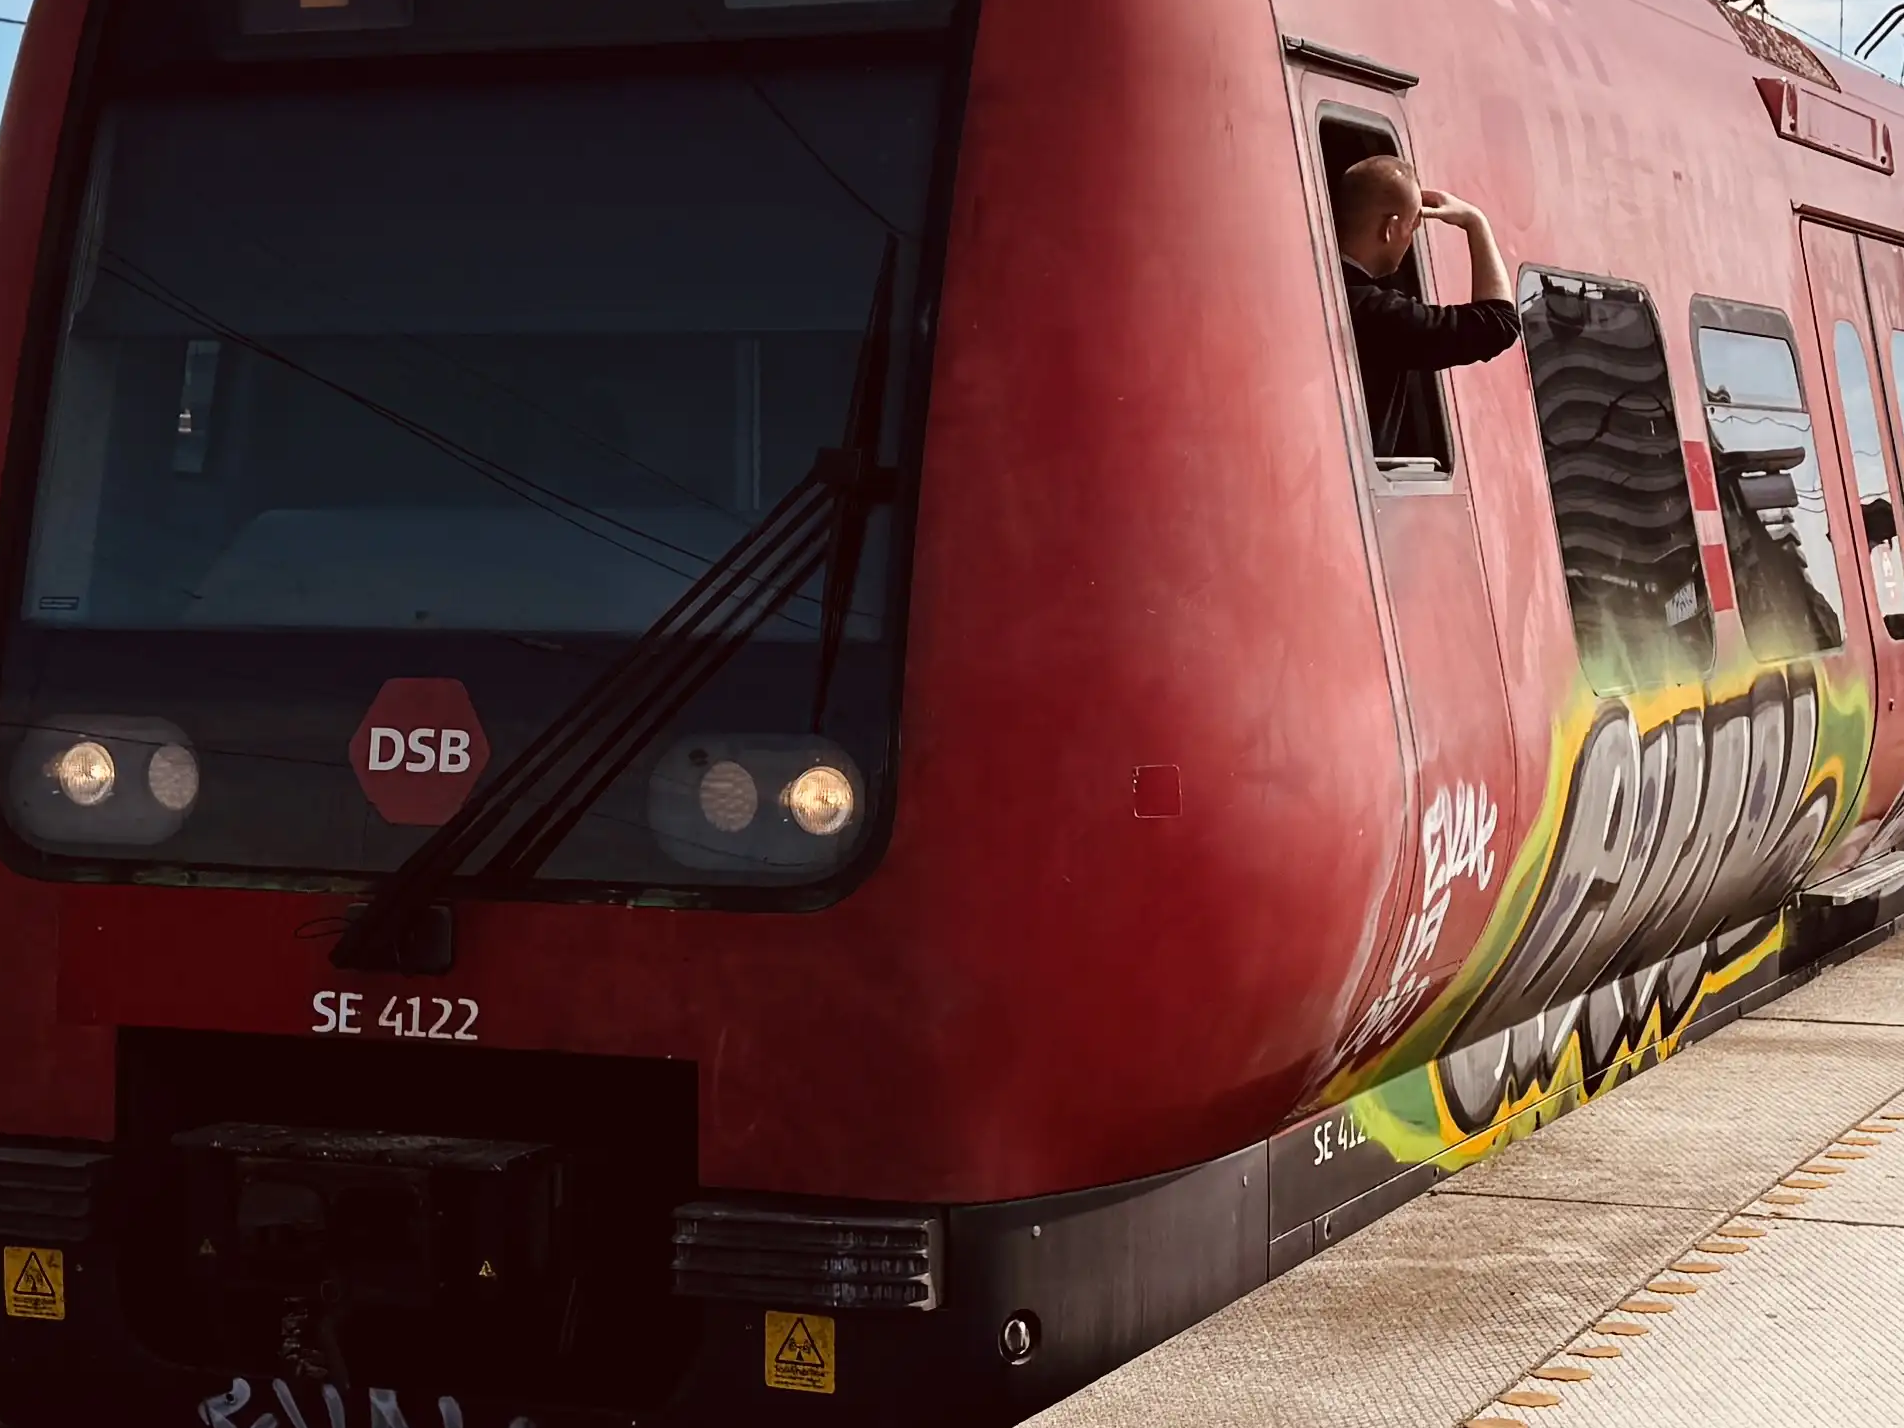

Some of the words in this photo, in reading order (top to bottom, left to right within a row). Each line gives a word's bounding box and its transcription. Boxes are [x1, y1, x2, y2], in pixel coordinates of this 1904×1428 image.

[368, 727, 471, 773] DSB
[311, 990, 364, 1034] SE
[378, 995, 479, 1041] 4122
[1313, 1120, 1334, 1166] SE
